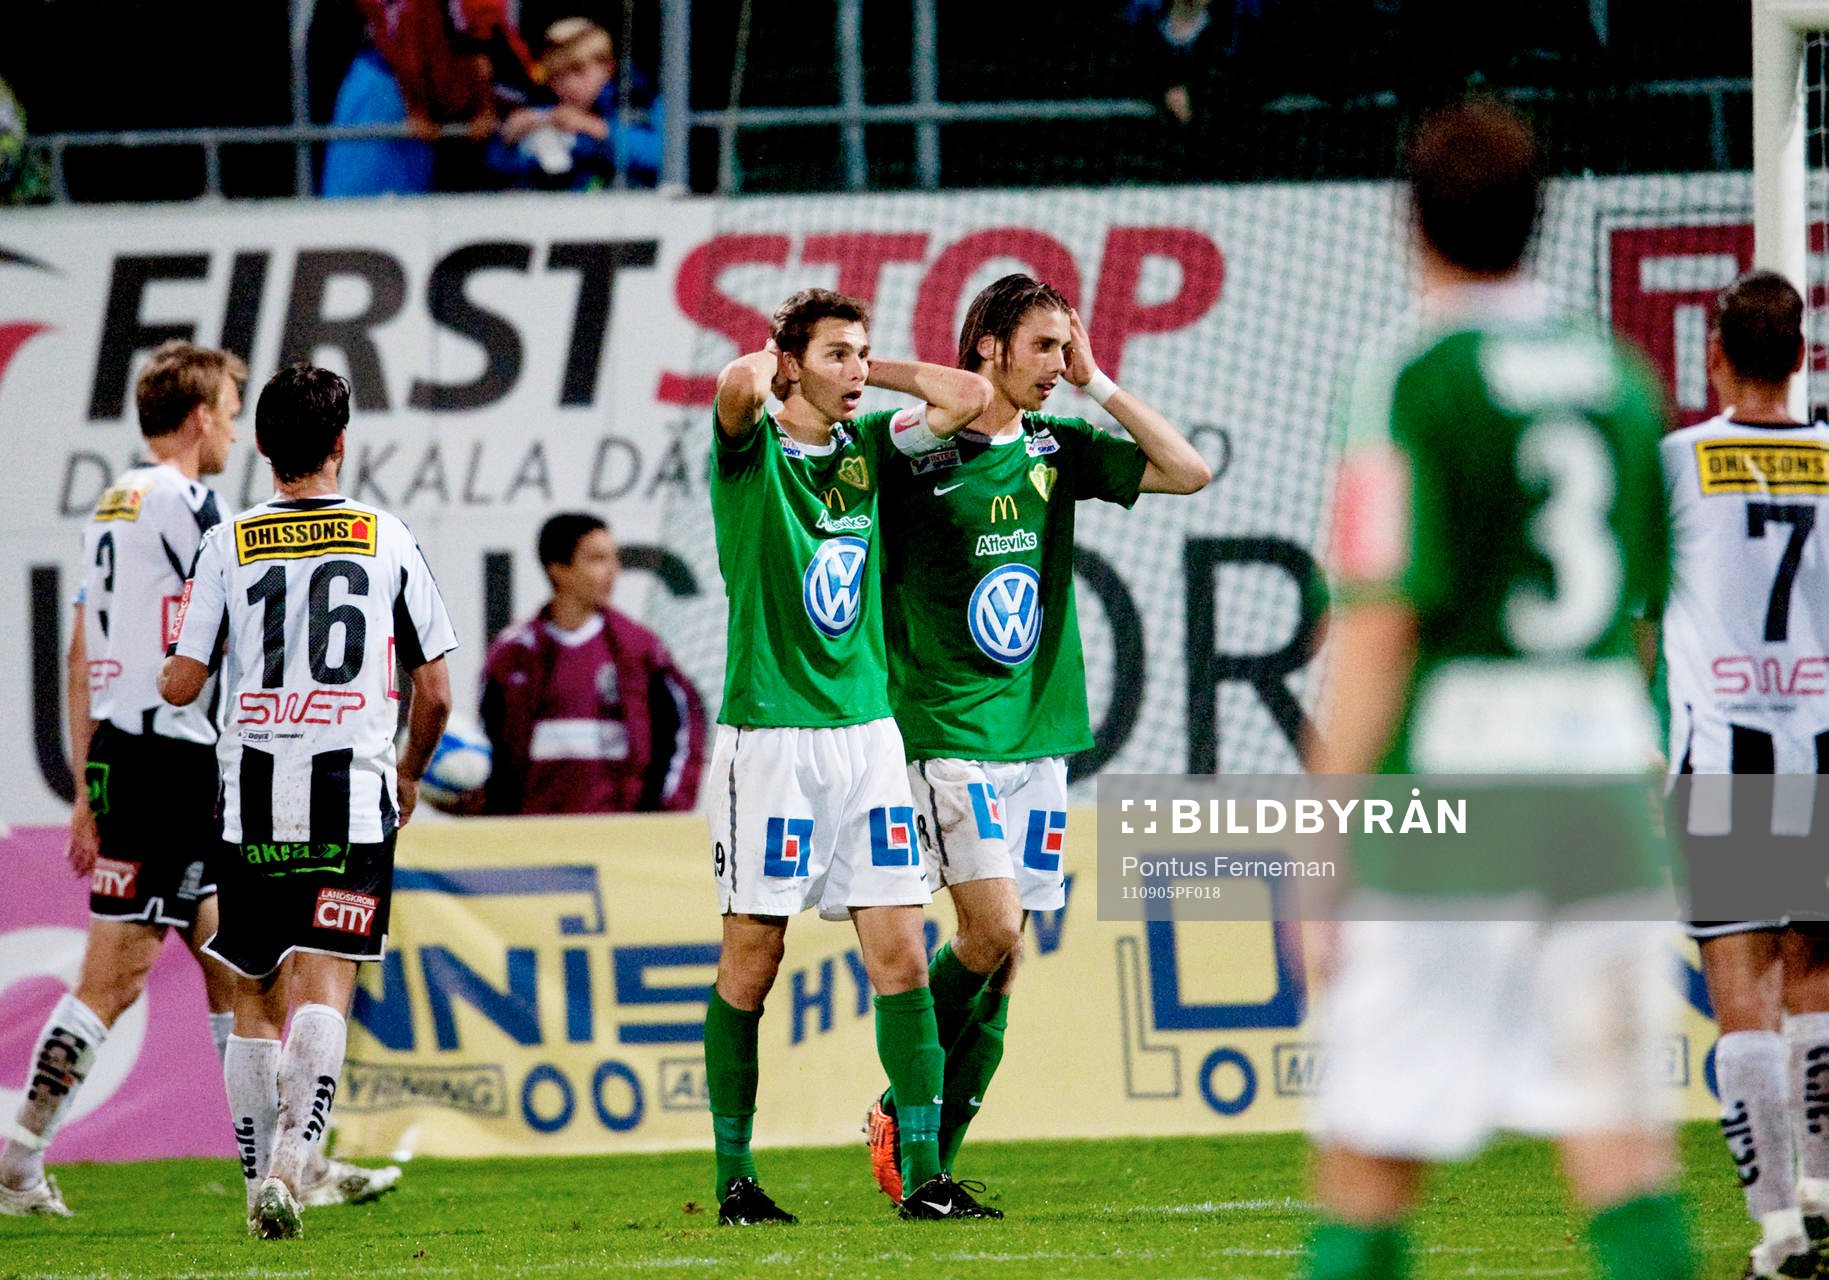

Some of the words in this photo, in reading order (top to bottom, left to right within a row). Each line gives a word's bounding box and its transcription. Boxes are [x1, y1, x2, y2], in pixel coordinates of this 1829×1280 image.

[240, 439, 554, 507] LKALA
[244, 521, 349, 548] OHLSSONS
[975, 529, 1038, 556] Atteviks
[1503, 412, 1625, 658] 3
[1746, 502, 1815, 642] 7
[246, 560, 370, 689] 16
[1712, 654, 1829, 695] SWE
[238, 689, 366, 725] SWEP
[317, 901, 373, 933] CITY
